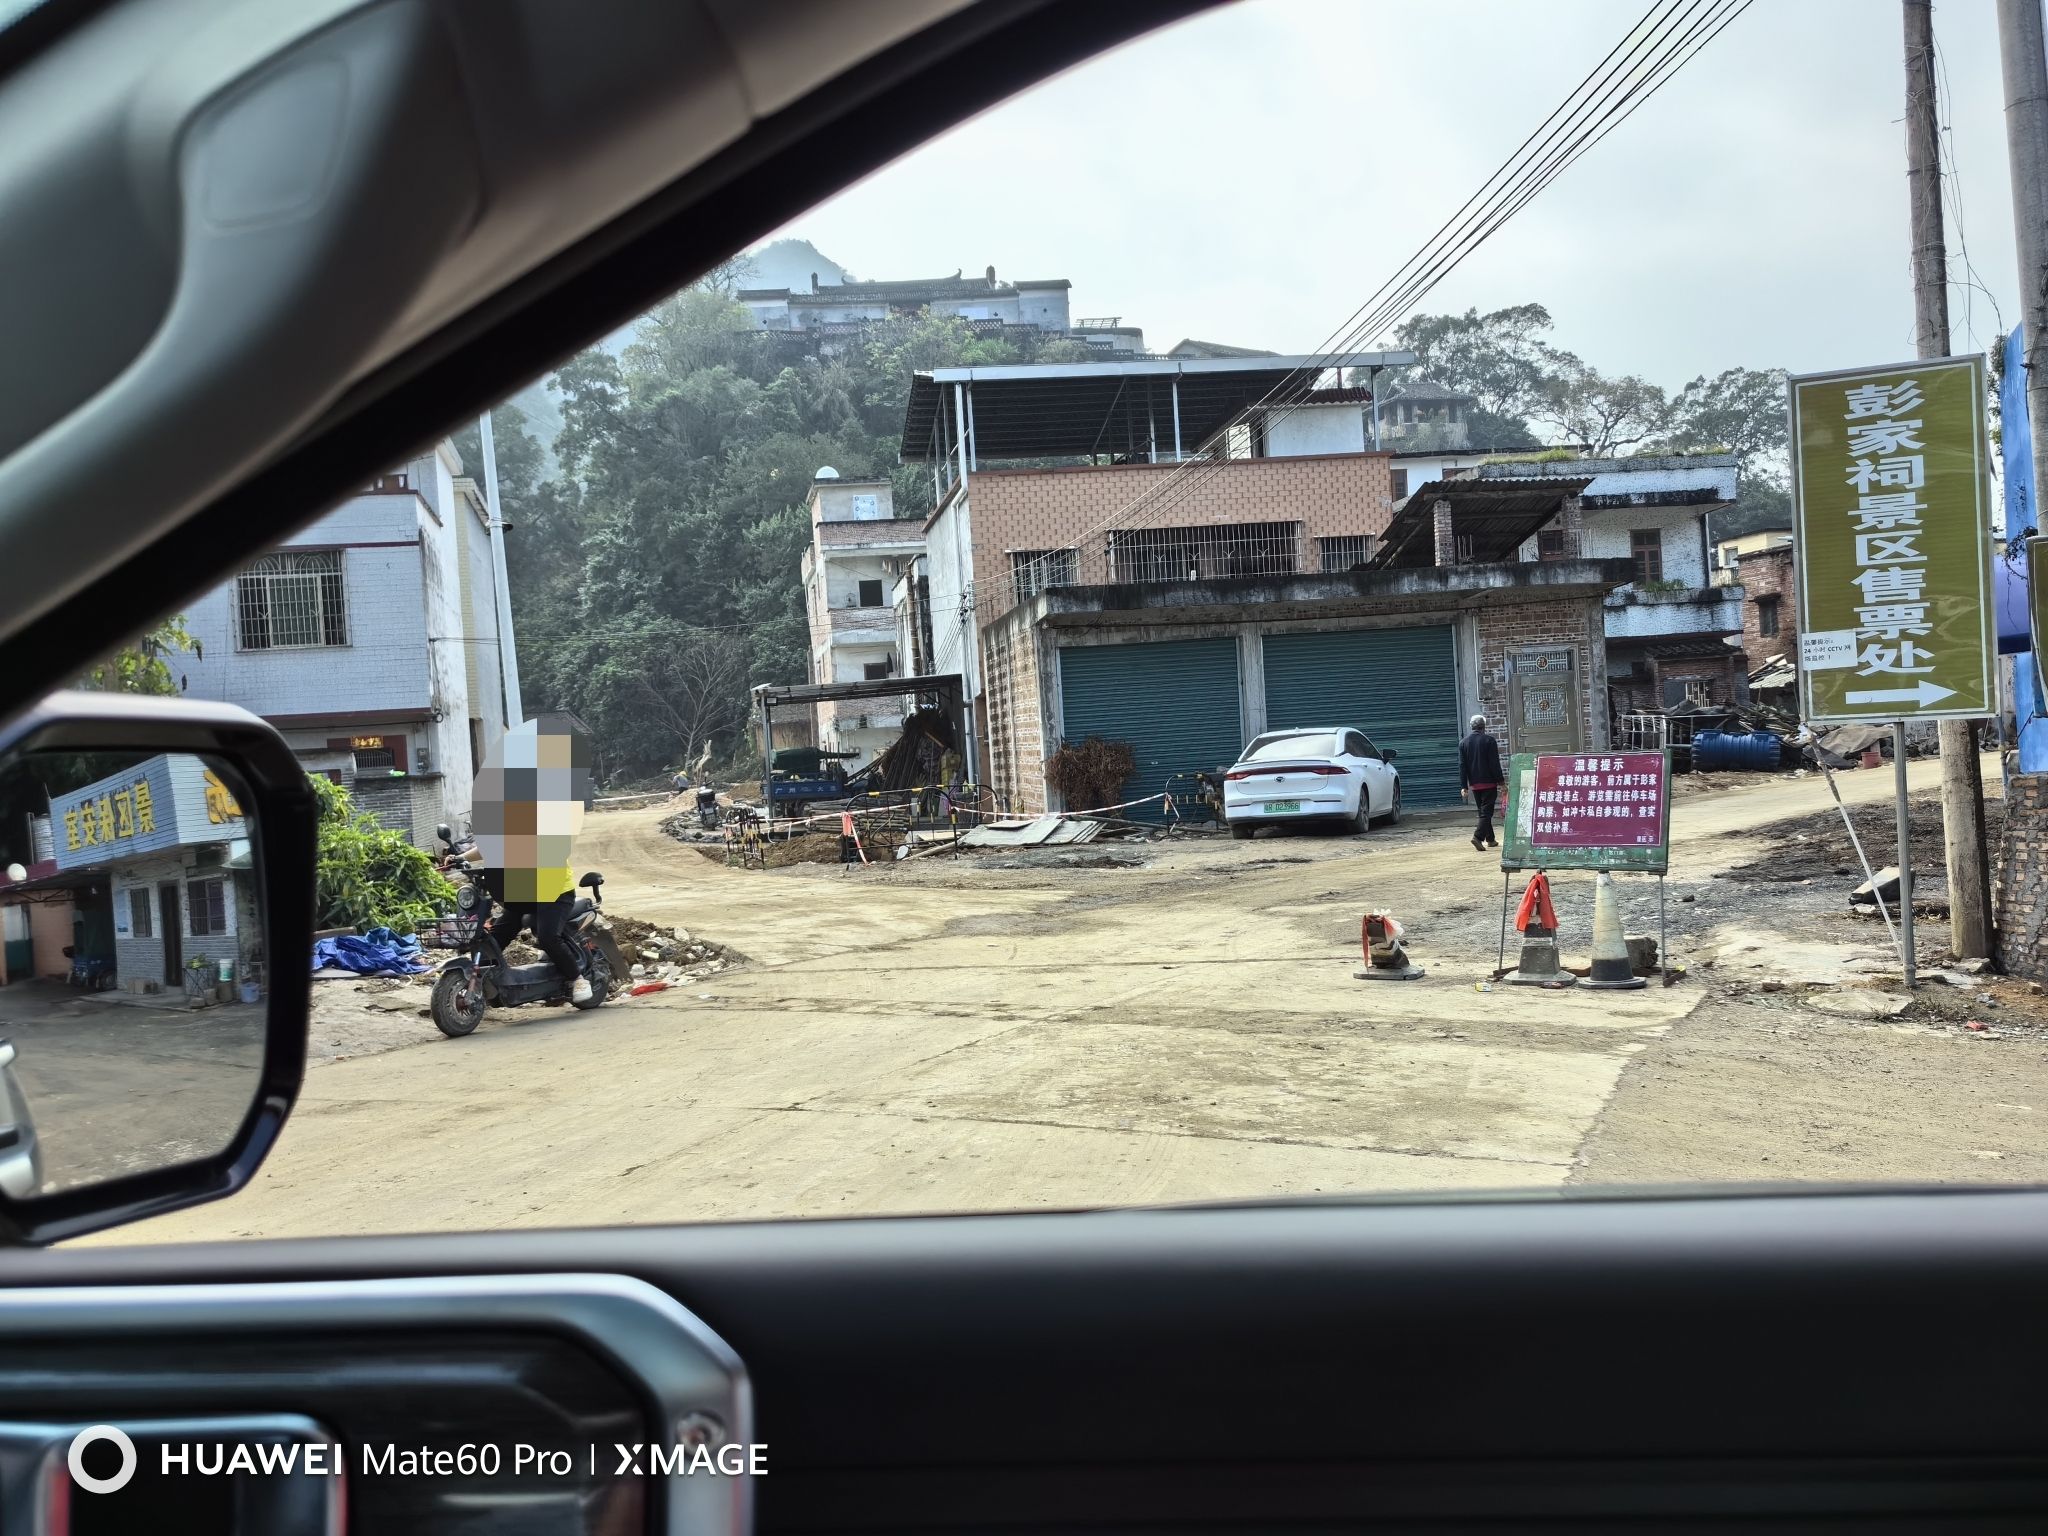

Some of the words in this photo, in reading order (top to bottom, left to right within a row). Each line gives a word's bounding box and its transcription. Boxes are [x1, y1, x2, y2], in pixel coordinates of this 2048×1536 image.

[1843, 379, 1936, 677] 彭家祠景区售票处
[1574, 758, 1625, 772] 温馨提示
[1558, 774, 1657, 786] 尊敬的游客，前方属于彭家
